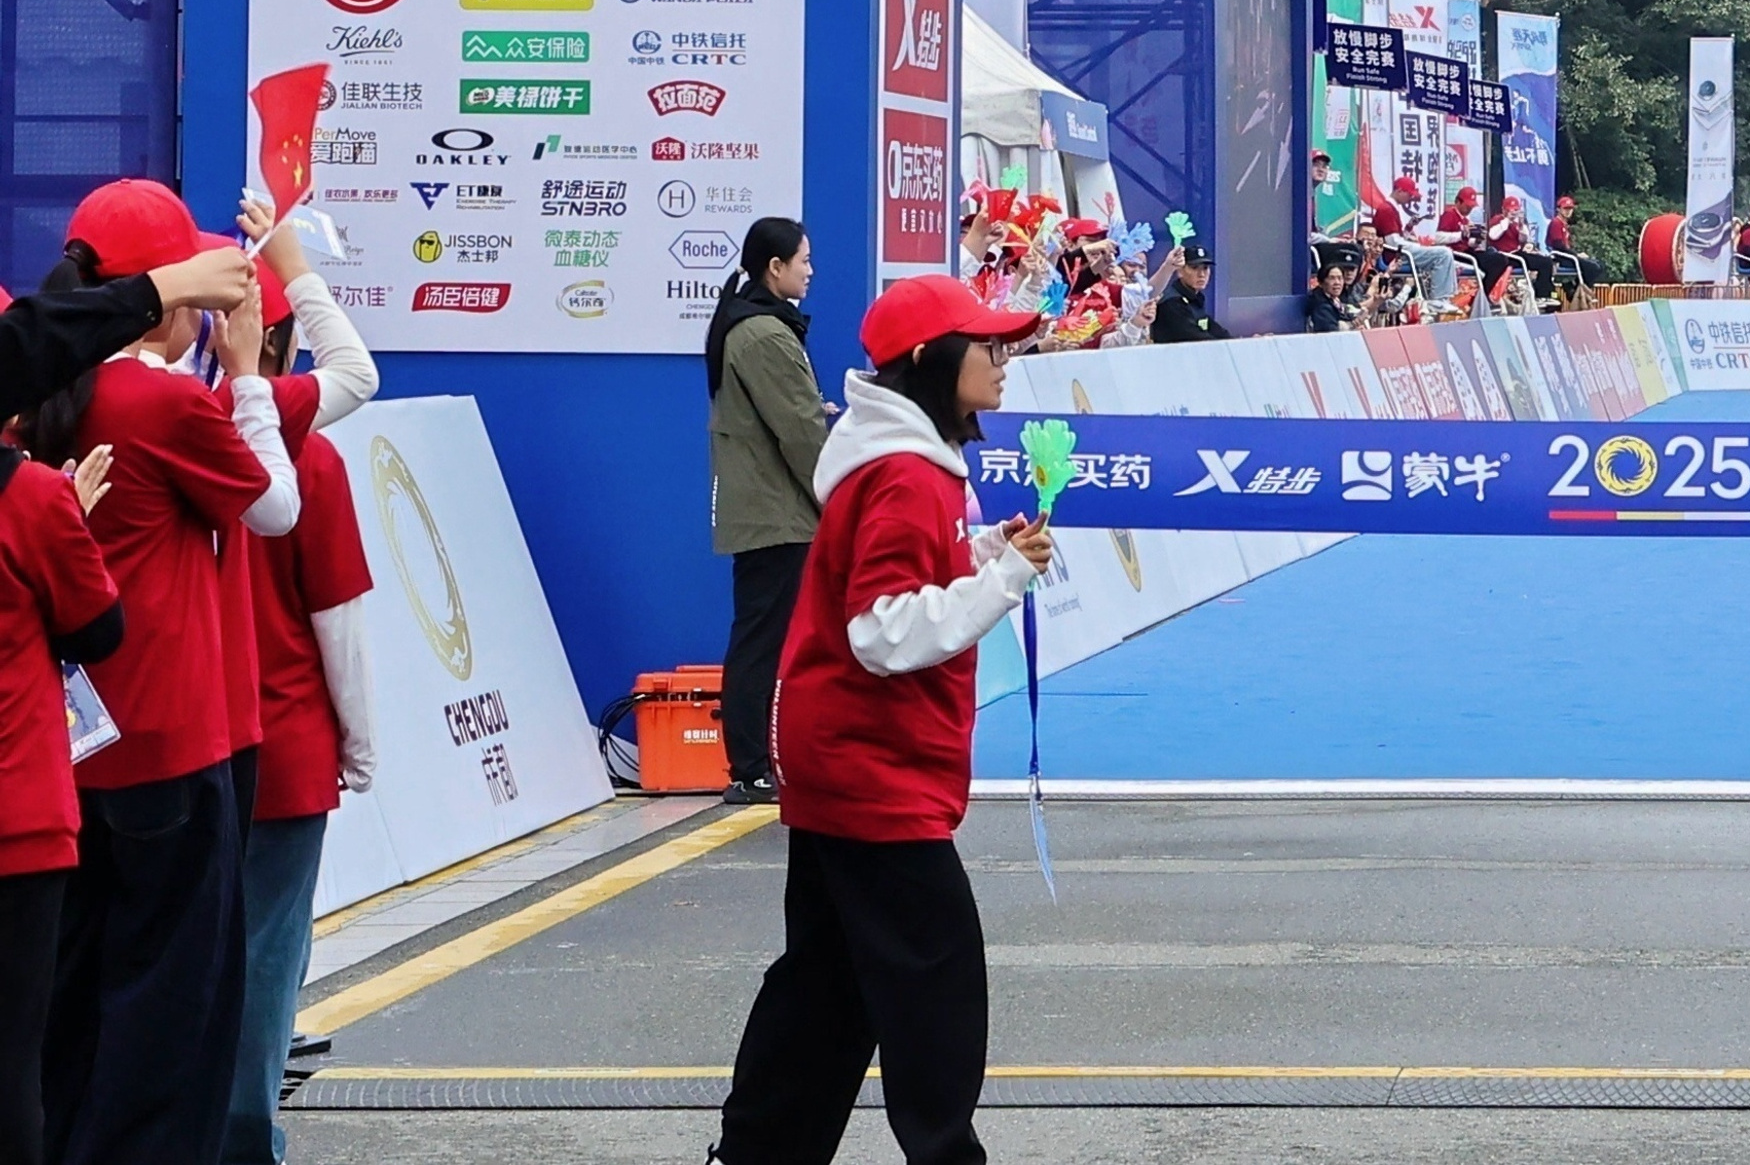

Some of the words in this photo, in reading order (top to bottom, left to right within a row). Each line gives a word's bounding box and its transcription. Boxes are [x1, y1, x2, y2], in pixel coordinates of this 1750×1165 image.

[326, 25, 404, 52] Kiehl's
[504, 37, 587, 60] 众安保险
[671, 32, 747, 50] 中铁信托
[1333, 28, 1393, 50] 放慢脚步
[671, 53, 747, 66] CRTC
[1334, 46, 1396, 69] 安全完赛
[1412, 57, 1461, 80] 放慢脚步
[340, 81, 424, 103] 佳联生技
[1413, 74, 1462, 97] 安全完赛
[340, 102, 378, 111] JIALIAN
[380, 102, 423, 111] BIOTECH
[492, 86, 584, 110] 美禄饼干
[313, 128, 377, 141] PerMove
[310, 141, 378, 165] 爱跑猫
[655, 141, 682, 156] 沃隆
[690, 141, 760, 161] 沃隆坚果
[415, 154, 509, 166] OAKLEY
[901, 142, 943, 203] 京东买药
[541, 180, 628, 201] 舒途运动
[705, 186, 754, 203] 华住会
[704, 204, 753, 214] REWARDS
[444, 234, 513, 249] JISSBON
[544, 229, 620, 249] 微泰动态
[682, 240, 728, 258] Roche
[456, 249, 500, 264] 杰士邦
[553, 249, 610, 268] 血糖仪
[422, 286, 501, 308] 汤臣倍健
[666, 280, 724, 300] Hilto
[1242, 466, 1324, 495] 特步
[1402, 451, 1500, 502] 蒙牛
[443, 689, 510, 747] CHENGDU
